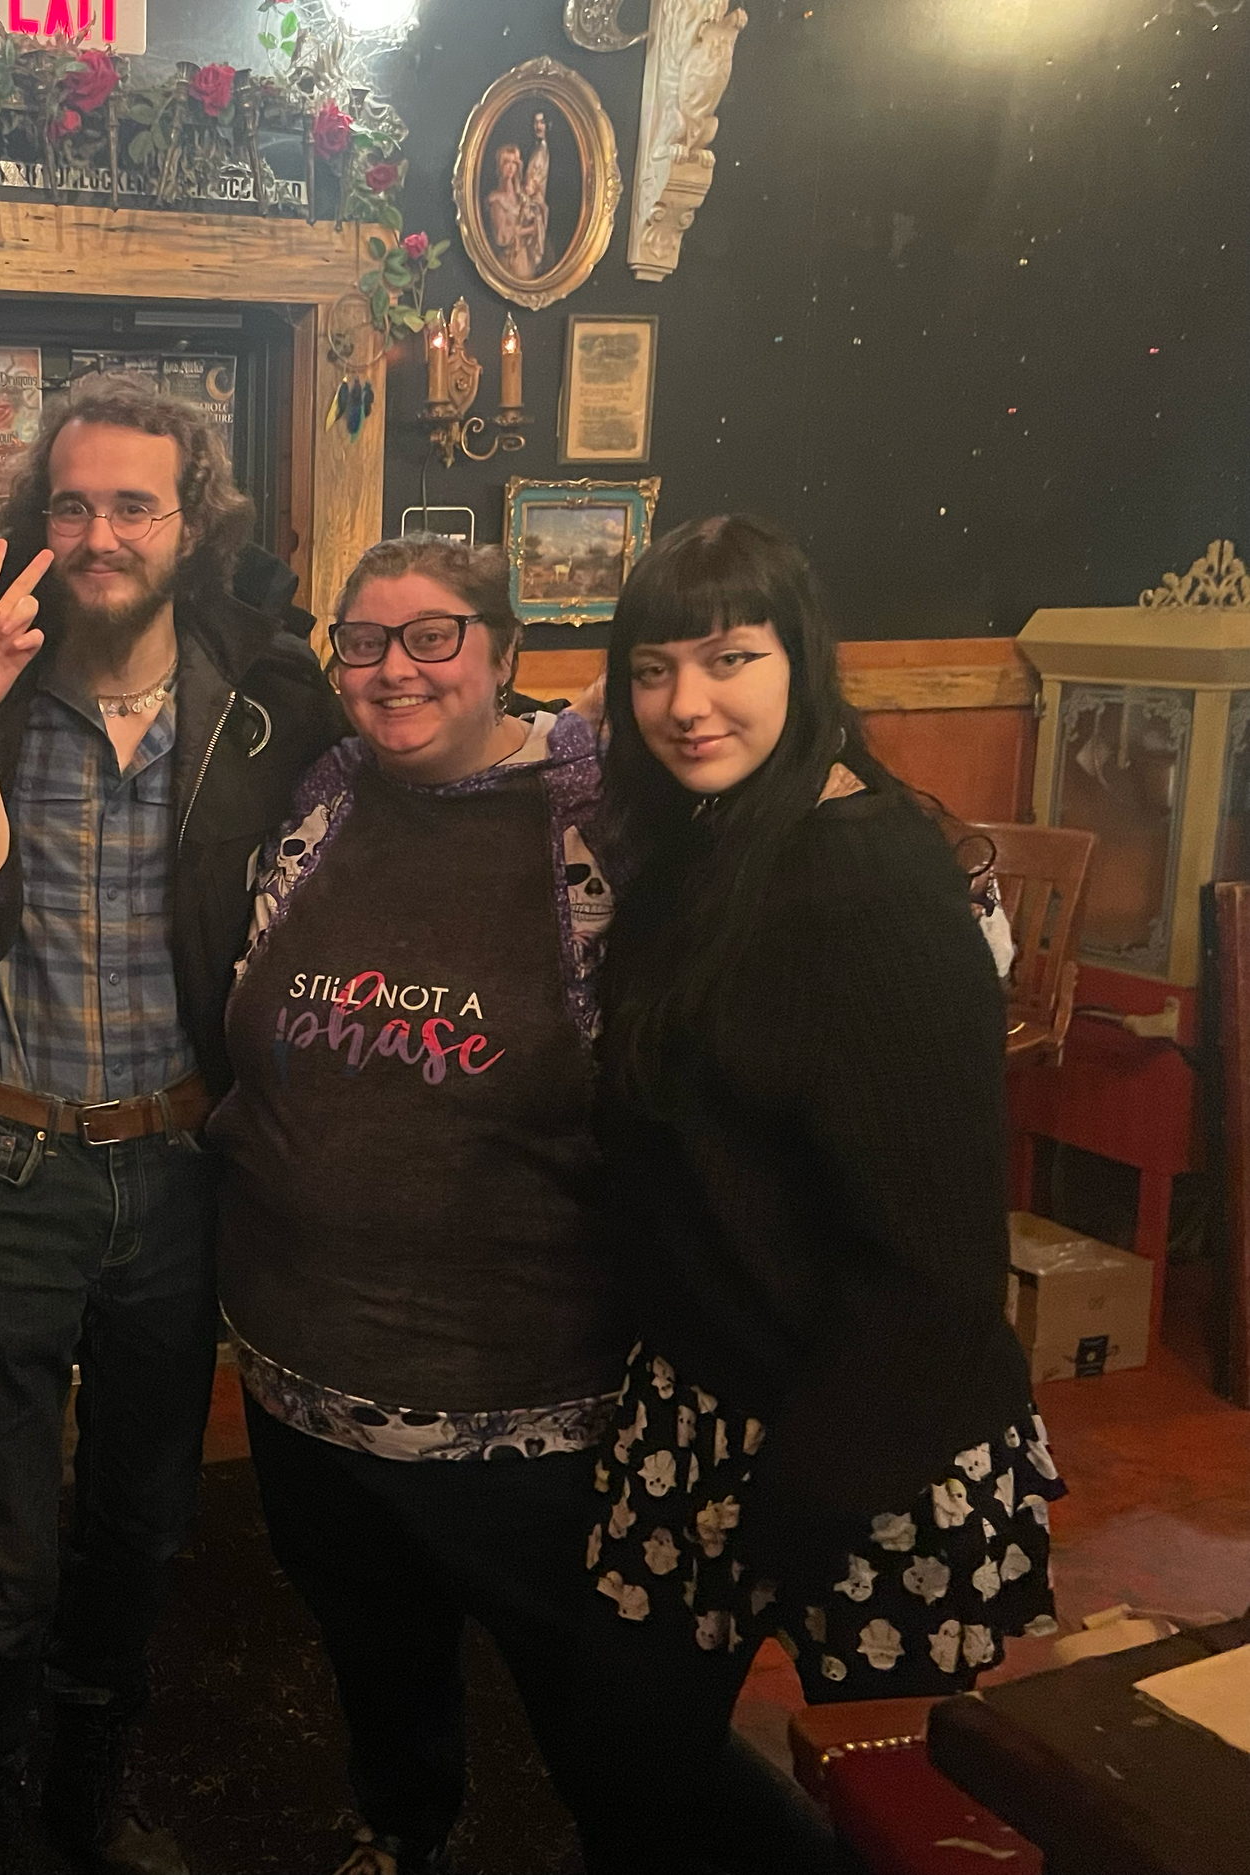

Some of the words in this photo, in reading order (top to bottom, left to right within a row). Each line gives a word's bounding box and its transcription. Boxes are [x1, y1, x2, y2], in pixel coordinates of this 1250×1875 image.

[272, 970, 506, 1092] phase
[289, 973, 361, 1006] STILL
[375, 982, 449, 1013] NOT
[459, 991, 483, 1020] A
